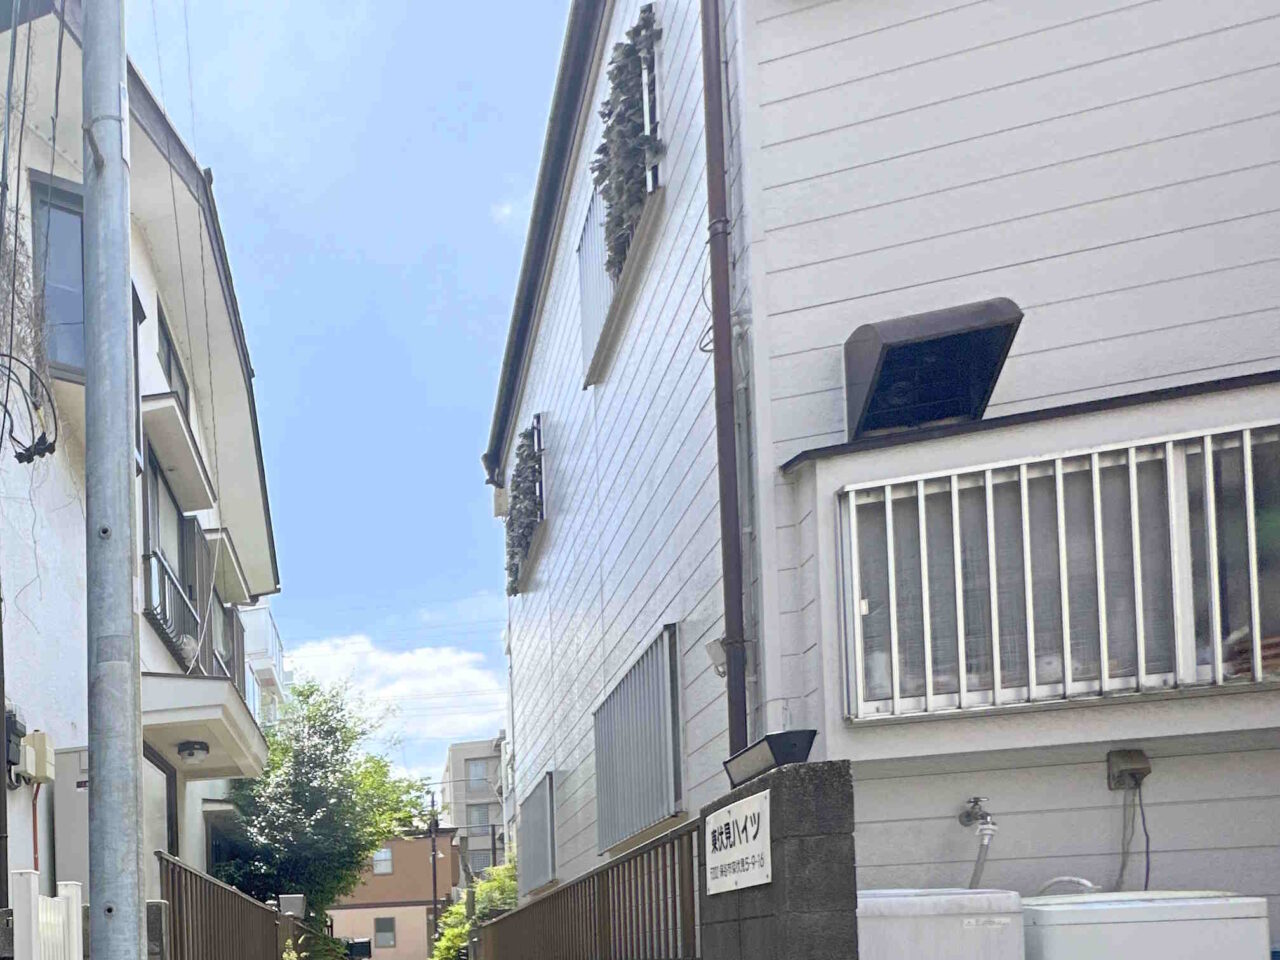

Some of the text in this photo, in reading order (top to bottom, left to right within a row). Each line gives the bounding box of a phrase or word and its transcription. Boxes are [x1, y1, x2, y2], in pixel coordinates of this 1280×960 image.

[711, 812, 760, 854] 東伏見ハイツ
